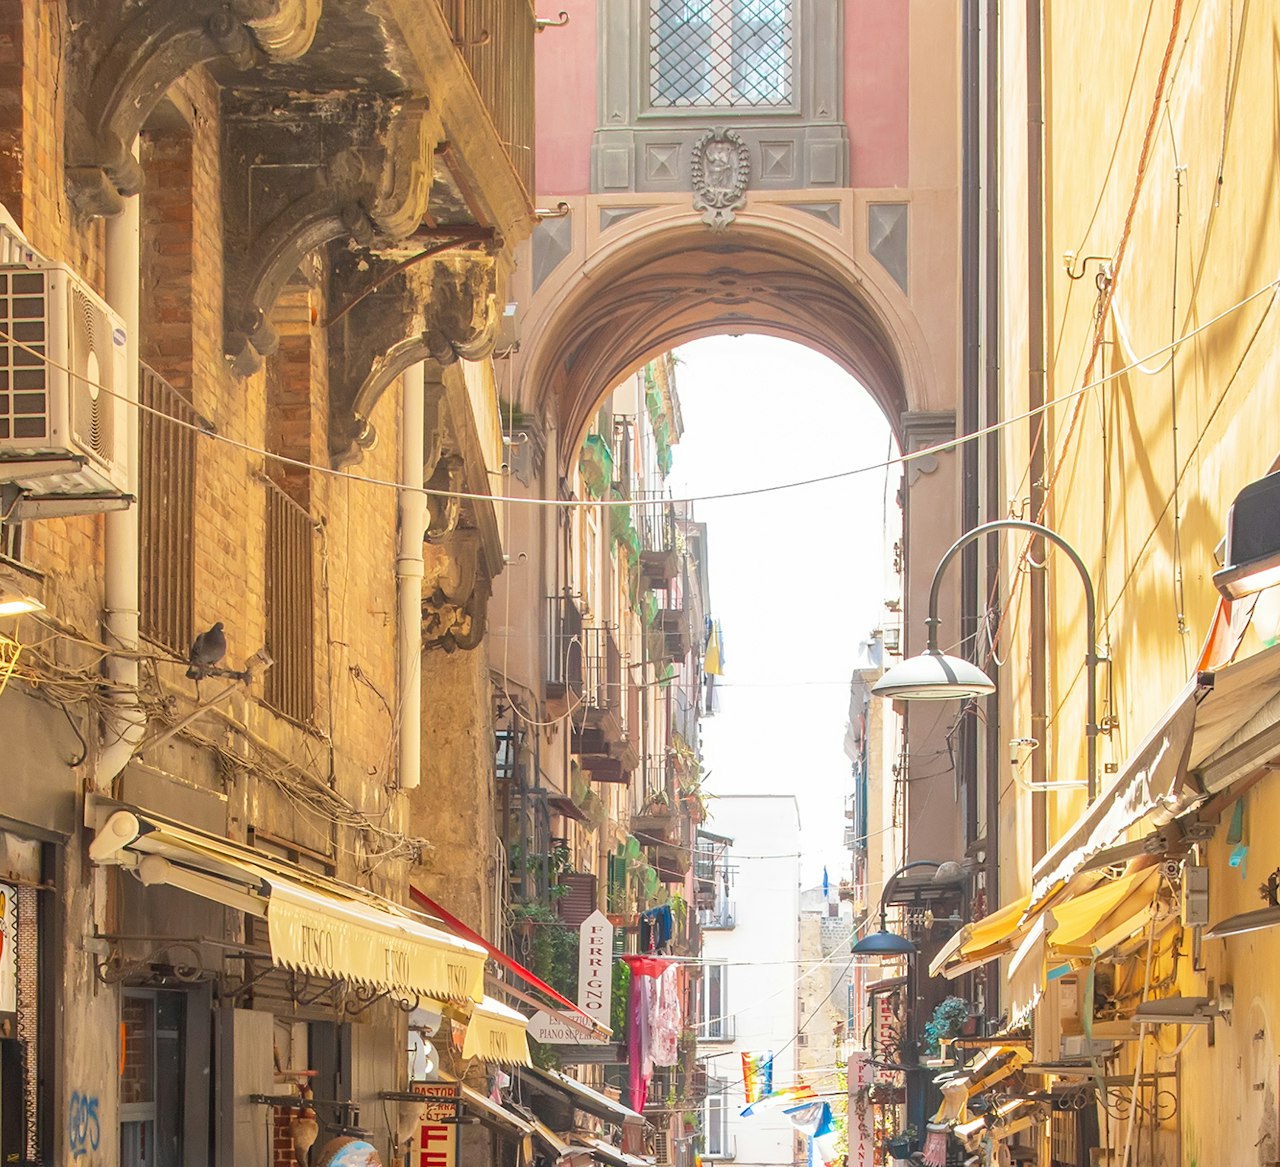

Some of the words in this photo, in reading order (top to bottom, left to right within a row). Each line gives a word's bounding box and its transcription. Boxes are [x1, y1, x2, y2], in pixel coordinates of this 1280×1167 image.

[302, 924, 334, 970] FUSCO
[586, 925, 604, 1010] FERRIGNO
[539, 1028, 564, 1039] PIANO
